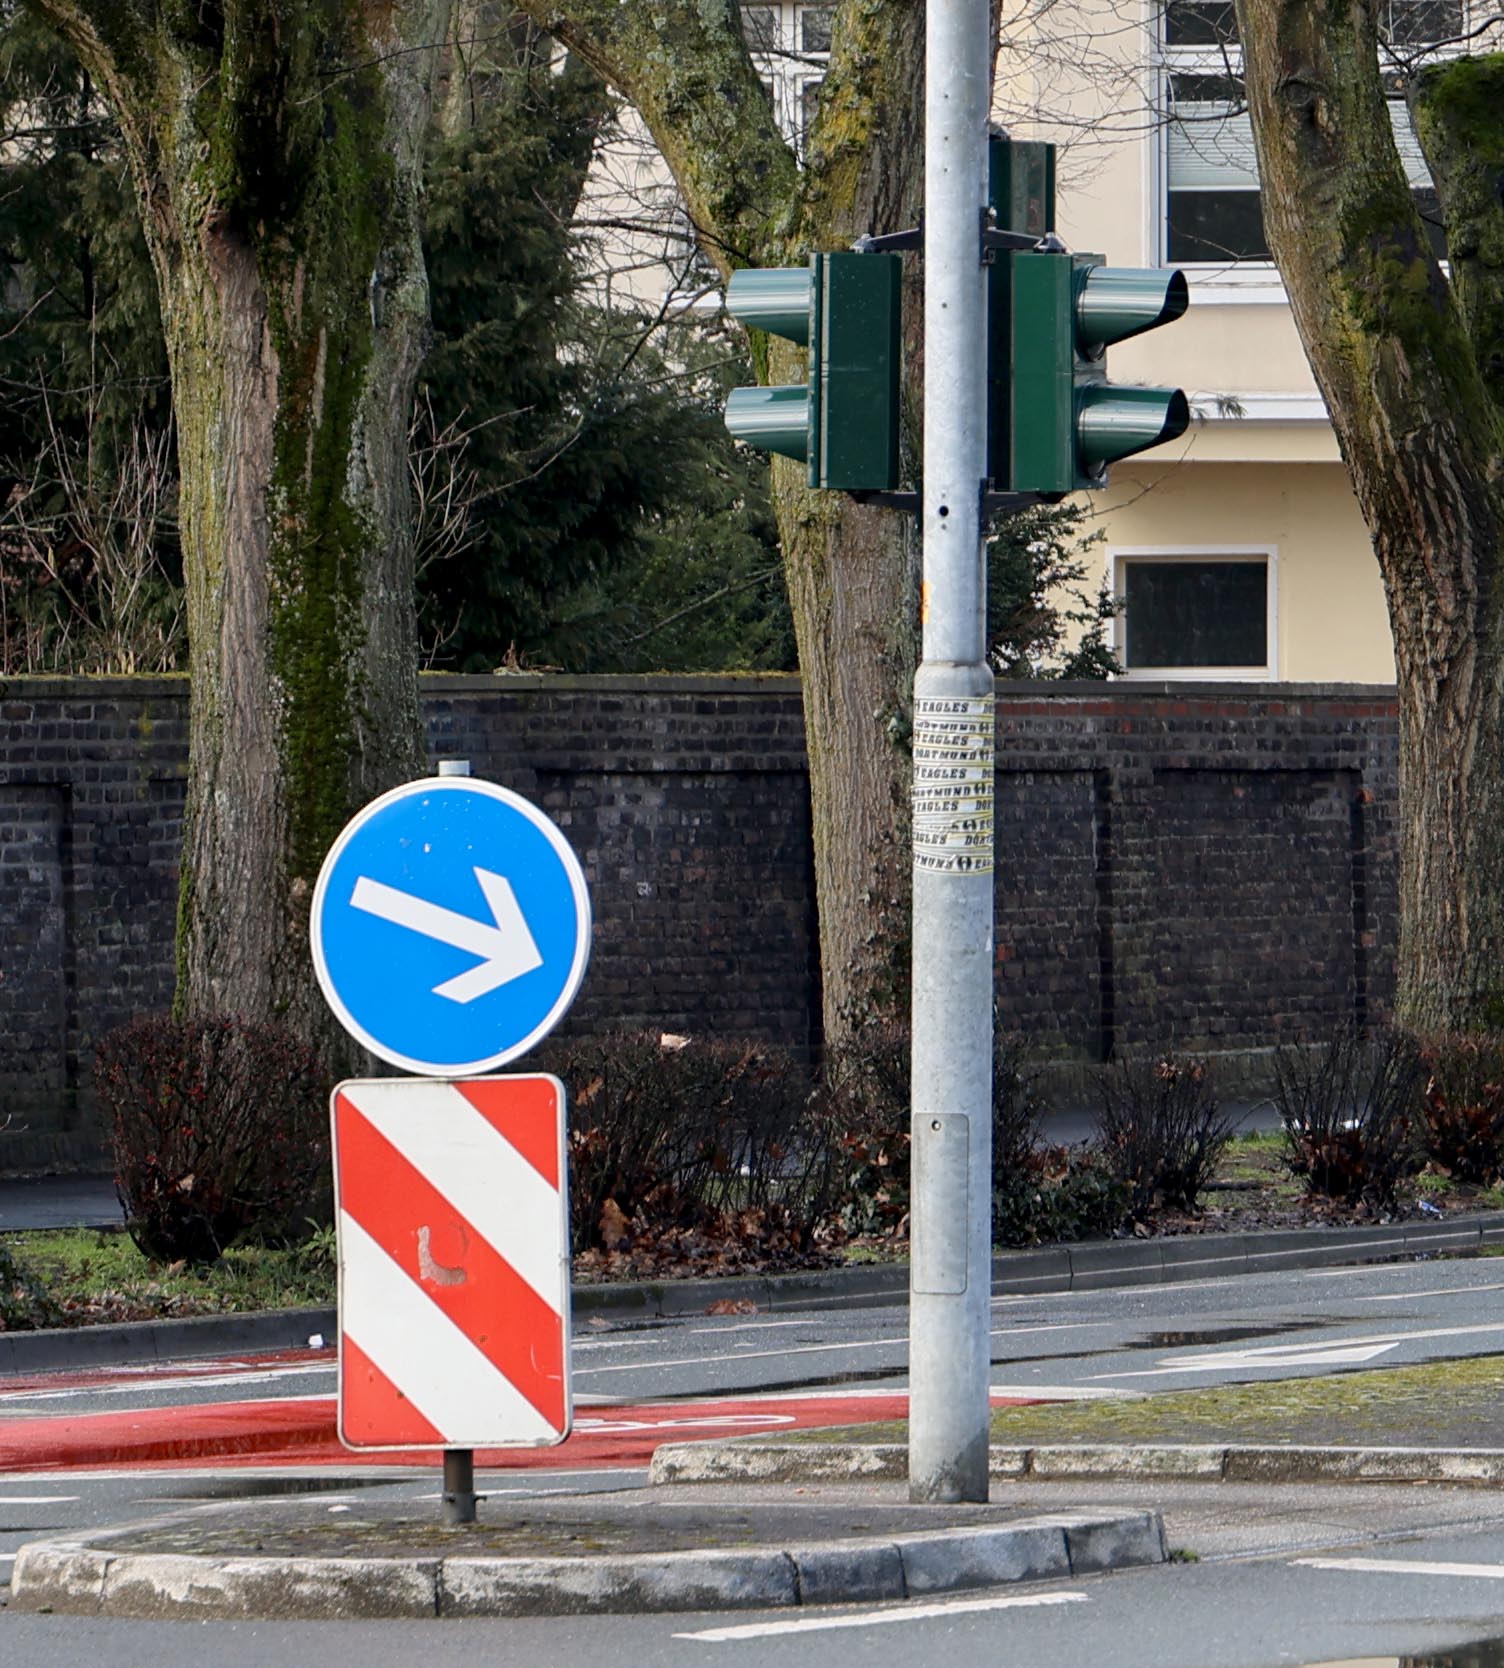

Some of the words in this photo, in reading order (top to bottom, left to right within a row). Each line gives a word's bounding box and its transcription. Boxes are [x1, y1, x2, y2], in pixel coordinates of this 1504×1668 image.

[922, 702, 969, 713] EAGLES
[922, 733, 968, 746] EAGLES
[921, 768, 967, 779] EAGLES
[917, 801, 959, 812] EAGLES
